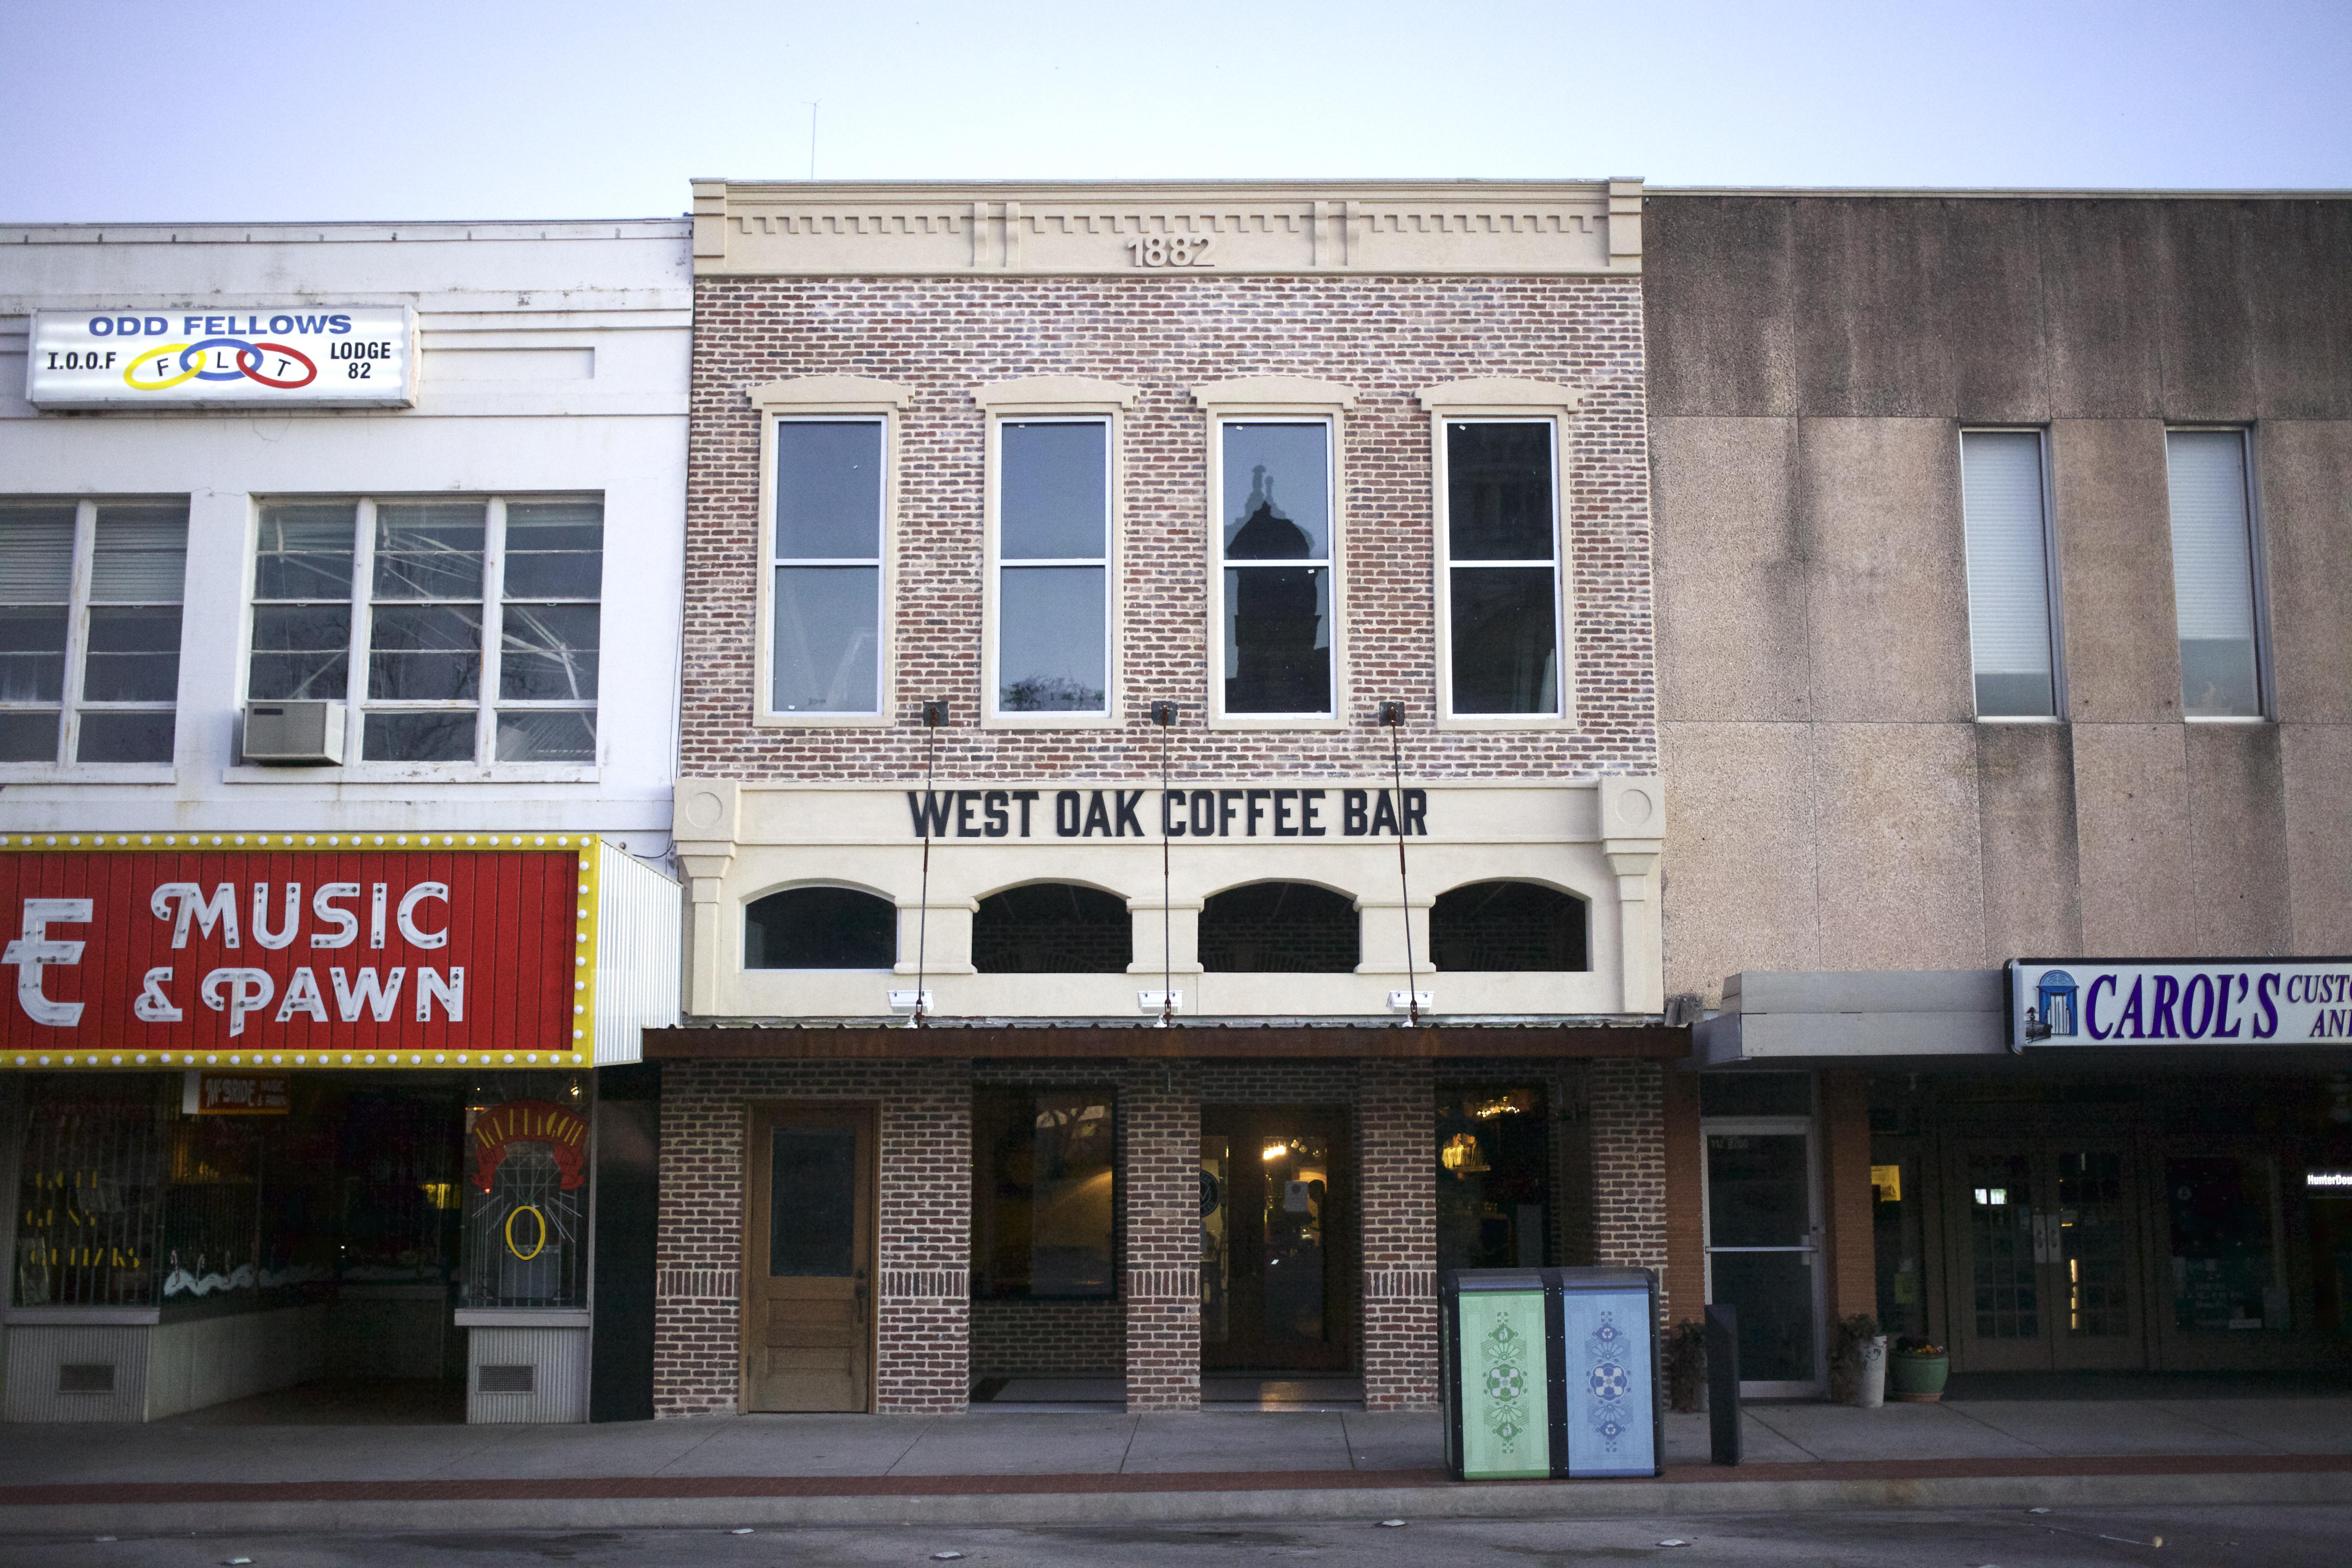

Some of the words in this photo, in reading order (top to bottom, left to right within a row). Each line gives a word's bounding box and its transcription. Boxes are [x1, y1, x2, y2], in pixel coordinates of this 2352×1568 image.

[1127, 232, 1215, 266] 1882
[88, 317, 168, 337] ODD
[184, 315, 352, 335] FELLOWS
[47, 351, 117, 370] I.O.O.F
[157, 358, 169, 377] F
[216, 352, 229, 369] L
[277, 359, 291, 377] T
[330, 342, 391, 360] LODGE
[348, 363, 371, 379] 82
[908, 790, 1039, 838] WEST
[1057, 790, 1145, 837] OAK
[1162, 789, 1326, 836] COFFEE
[1344, 789, 1428, 836] BAR
[151, 881, 448, 949] MUSIC
[134, 966, 183, 1022] &
[201, 966, 464, 1038] PAWN
[2287, 974, 2352, 1003] CUST
[2086, 972, 2281, 1040] CAROL'S
